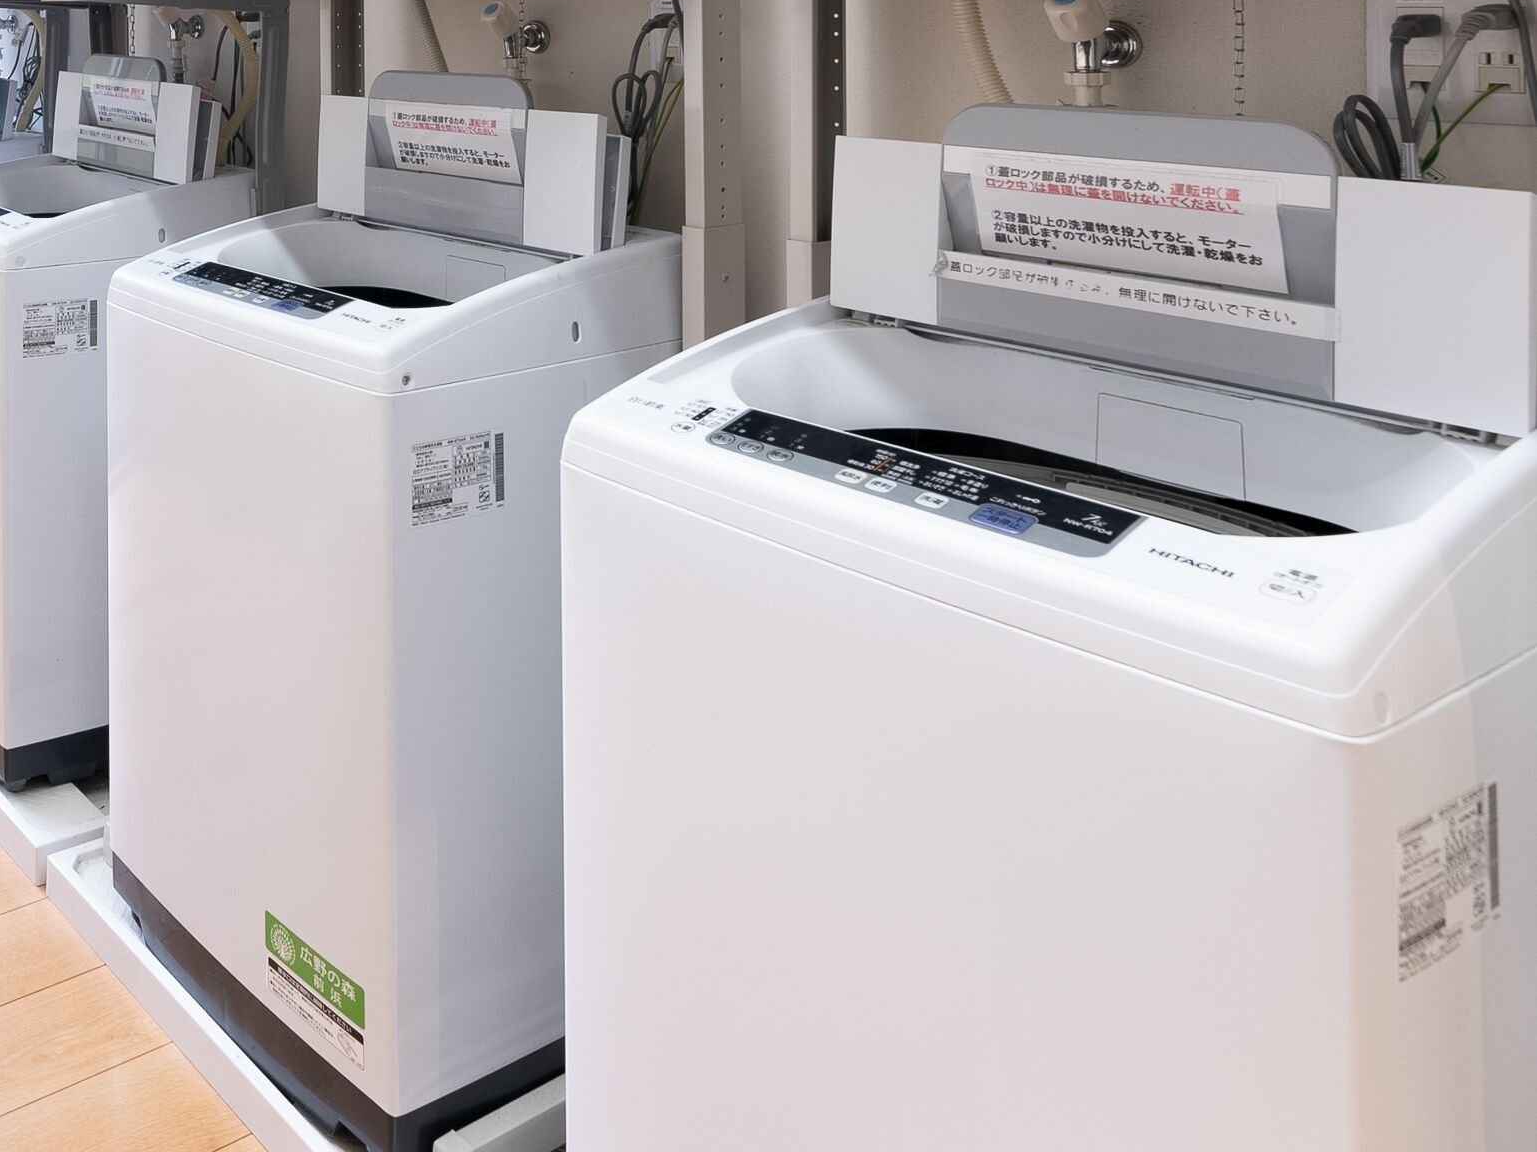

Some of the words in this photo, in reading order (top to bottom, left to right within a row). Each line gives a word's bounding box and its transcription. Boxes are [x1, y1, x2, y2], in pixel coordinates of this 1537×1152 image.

[995, 232, 1058, 251] 願いします。
[1148, 547, 1235, 578] HITACHI
